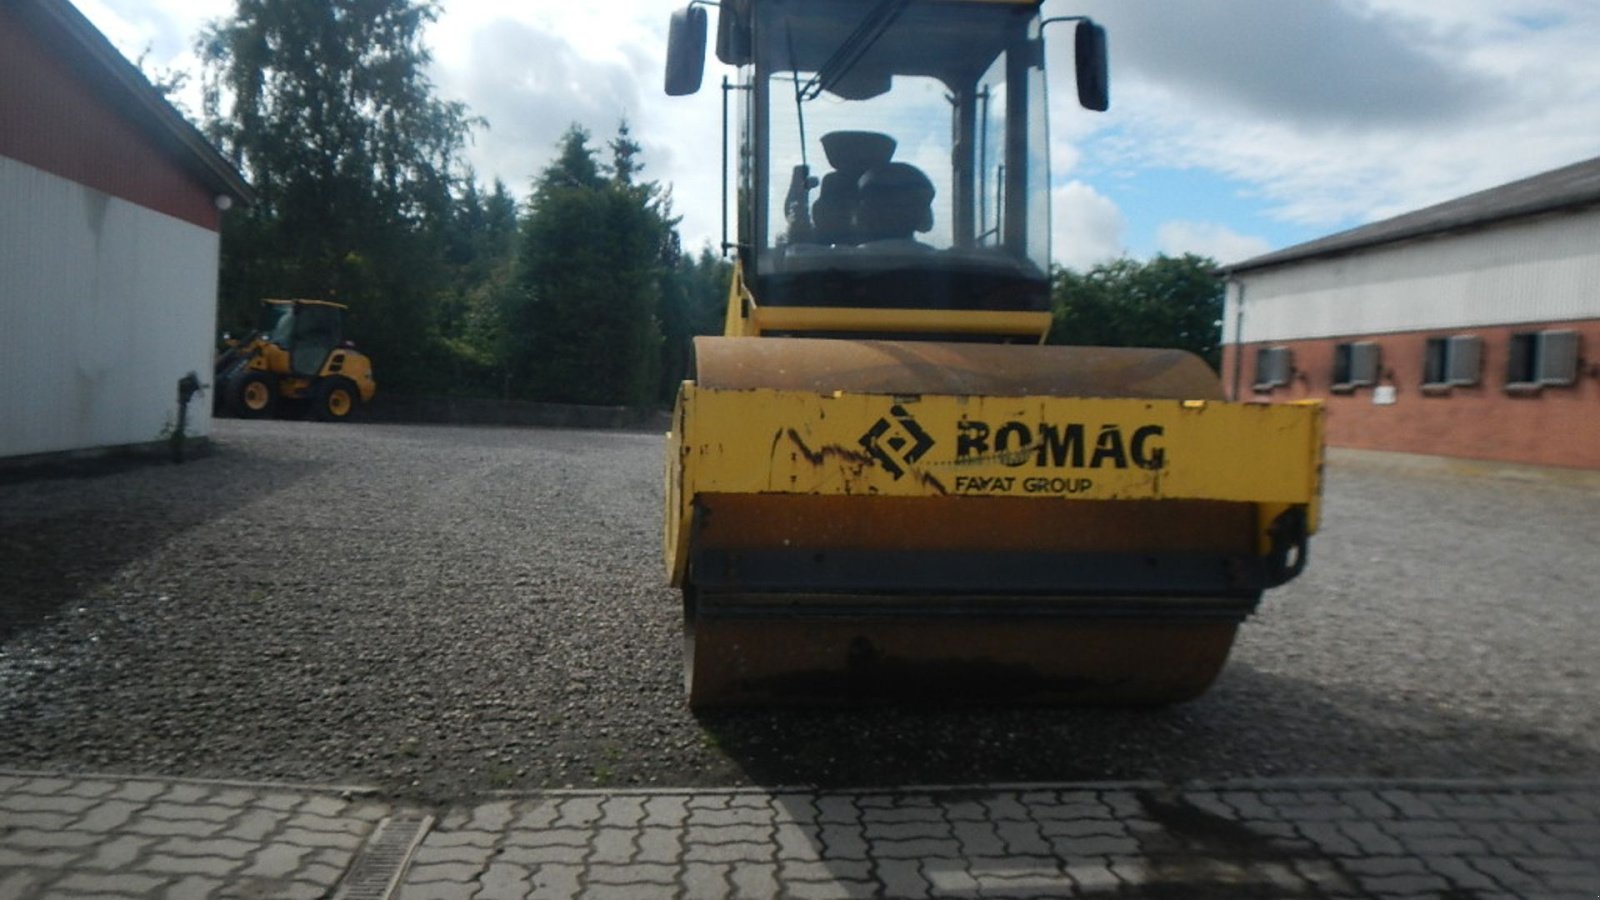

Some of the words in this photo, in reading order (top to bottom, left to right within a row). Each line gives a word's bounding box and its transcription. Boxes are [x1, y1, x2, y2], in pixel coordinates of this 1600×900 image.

[957, 421, 1164, 470] BOMAG
[956, 476, 1015, 492] FAYAT
[1023, 477, 1092, 493] GROUP
